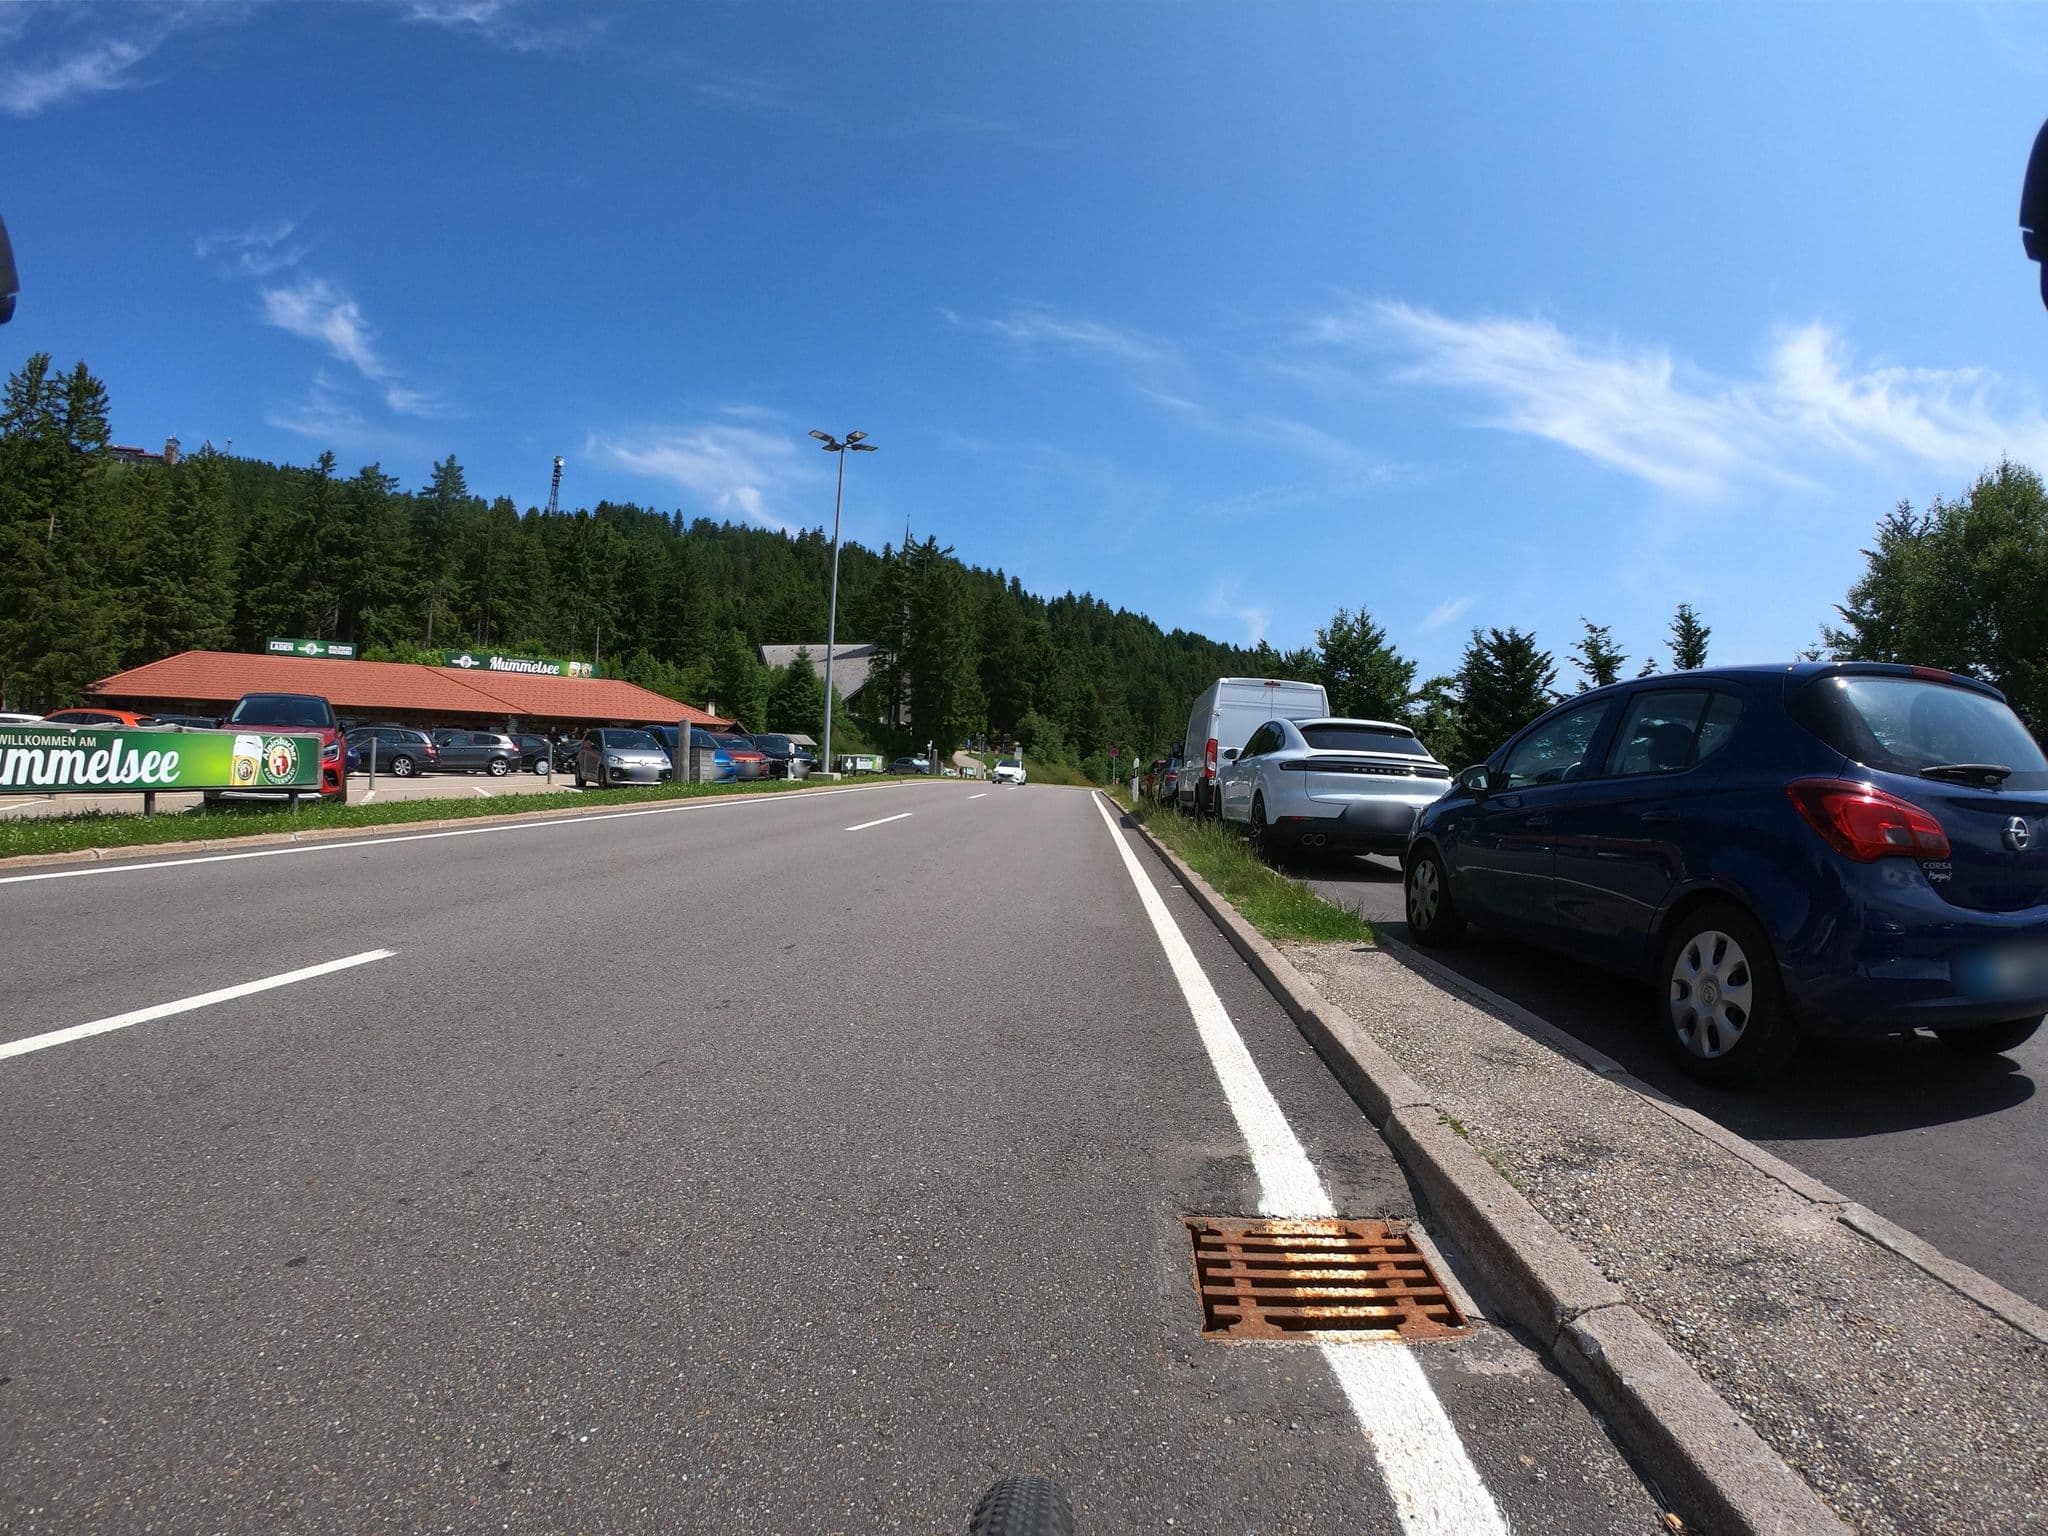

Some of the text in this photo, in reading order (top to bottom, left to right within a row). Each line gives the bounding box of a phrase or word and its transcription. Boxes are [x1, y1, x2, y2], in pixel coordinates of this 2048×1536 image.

[489, 656, 560, 675] Mummelsee
[0, 734, 97, 747] WILLKOMMEN AM
[0, 738, 181, 785] mmelsee
[1922, 862, 1953, 870] CORSA
